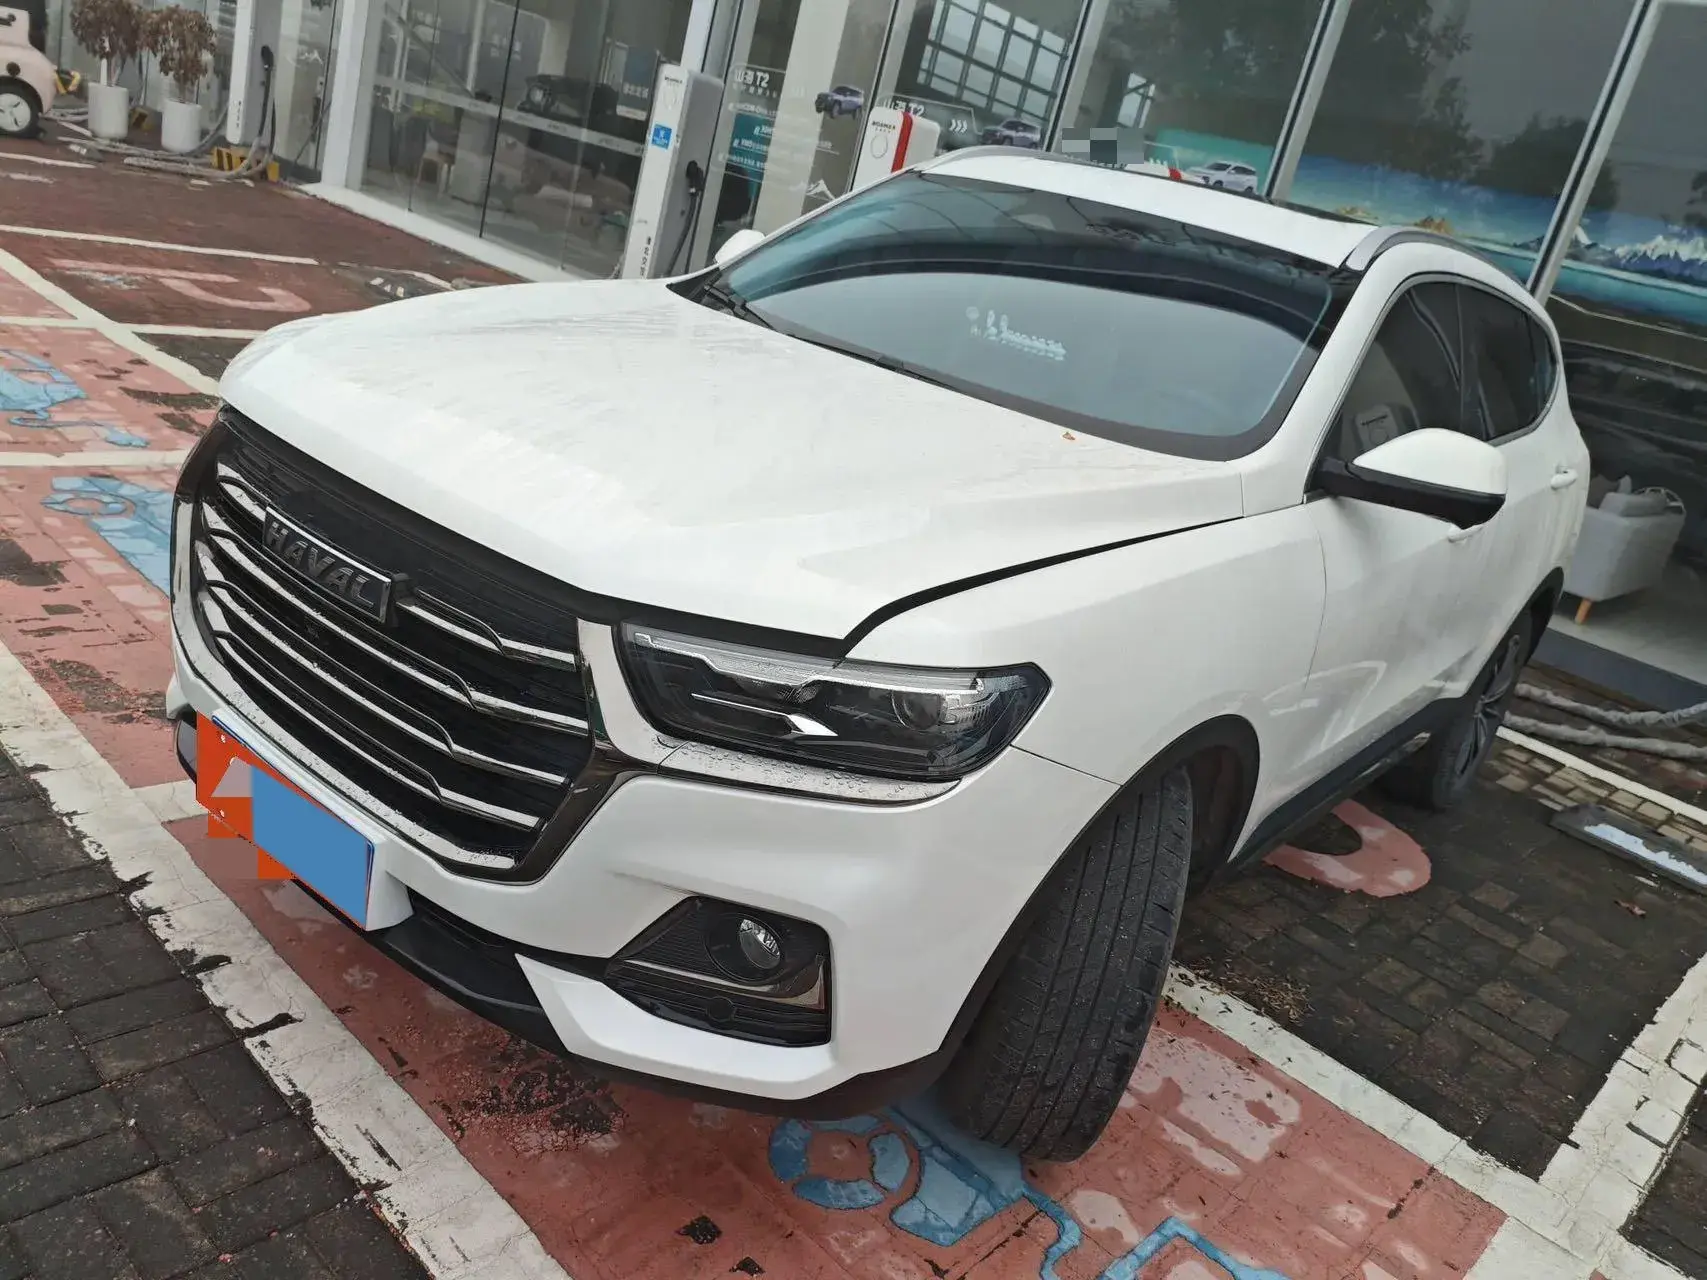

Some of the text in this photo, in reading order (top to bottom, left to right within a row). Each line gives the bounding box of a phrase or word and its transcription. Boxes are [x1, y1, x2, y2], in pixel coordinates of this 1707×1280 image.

[756, 71, 770, 88] T2
[908, 102, 925, 117] T2
[265, 521, 374, 608] HAVAL
